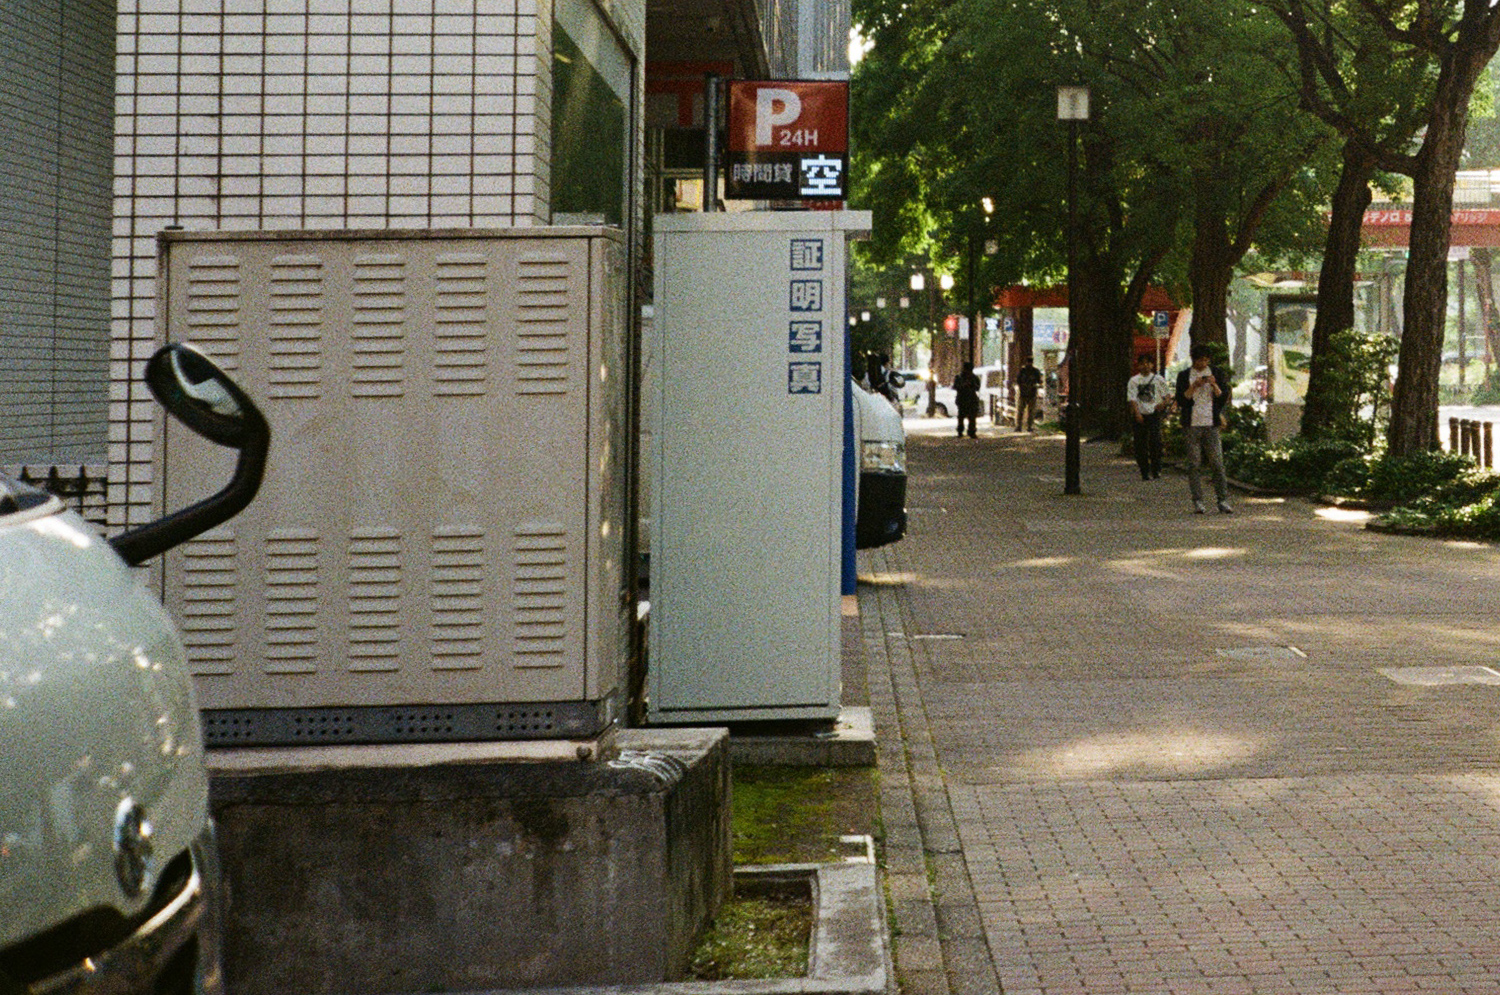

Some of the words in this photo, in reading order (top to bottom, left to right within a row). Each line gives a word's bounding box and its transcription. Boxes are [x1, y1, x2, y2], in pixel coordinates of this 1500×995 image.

[755, 87, 801, 146] P
[779, 129, 818, 146] 24H
[733, 163, 793, 184] 時間貸
[800, 154, 842, 196] 空
[789, 239, 823, 394] 証明写真
